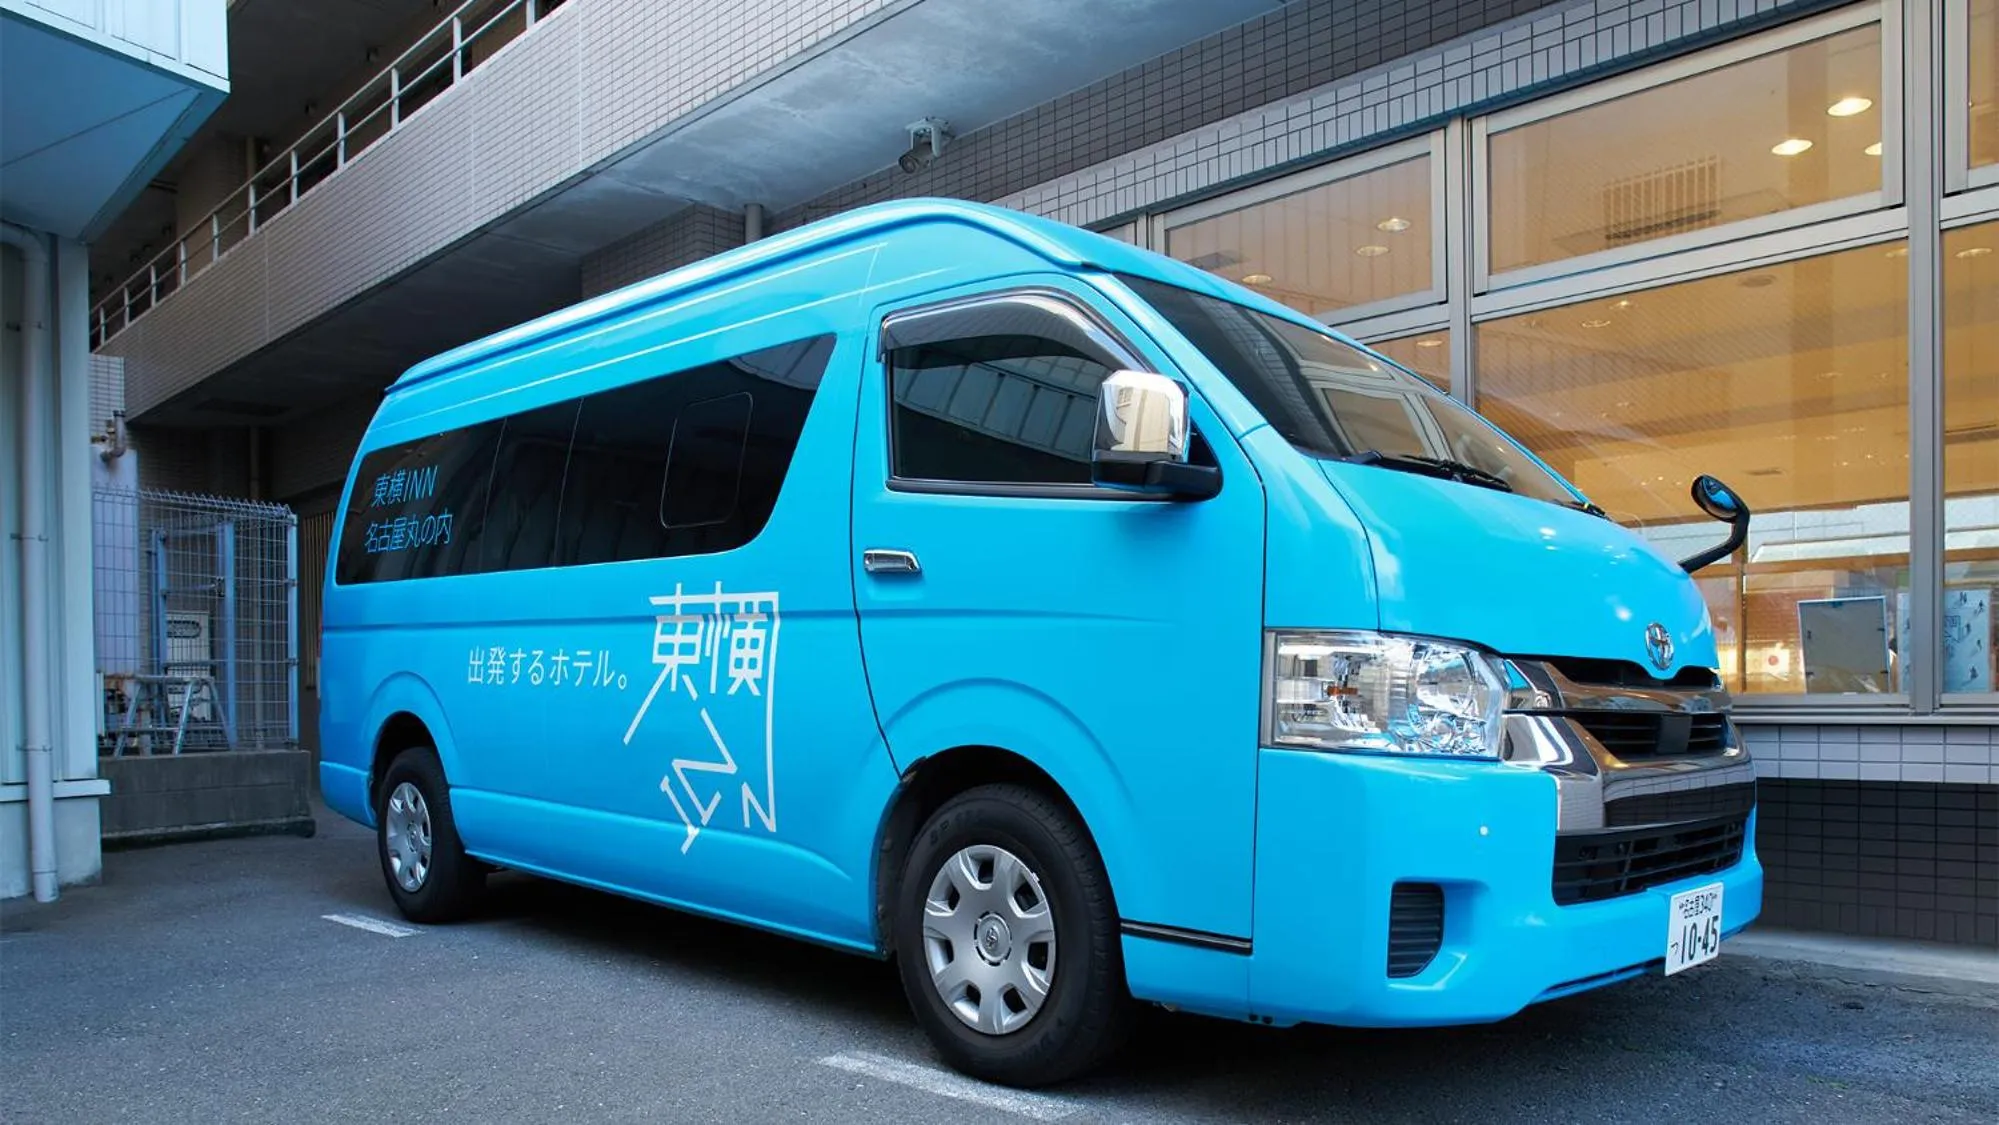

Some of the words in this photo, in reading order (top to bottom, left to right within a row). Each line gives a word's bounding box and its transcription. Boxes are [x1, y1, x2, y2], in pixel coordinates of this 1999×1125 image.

[371, 464, 438, 508] 東横INN
[364, 508, 453, 554] 名古屋丸の内
[467, 645, 627, 690] 出発するホテル。
